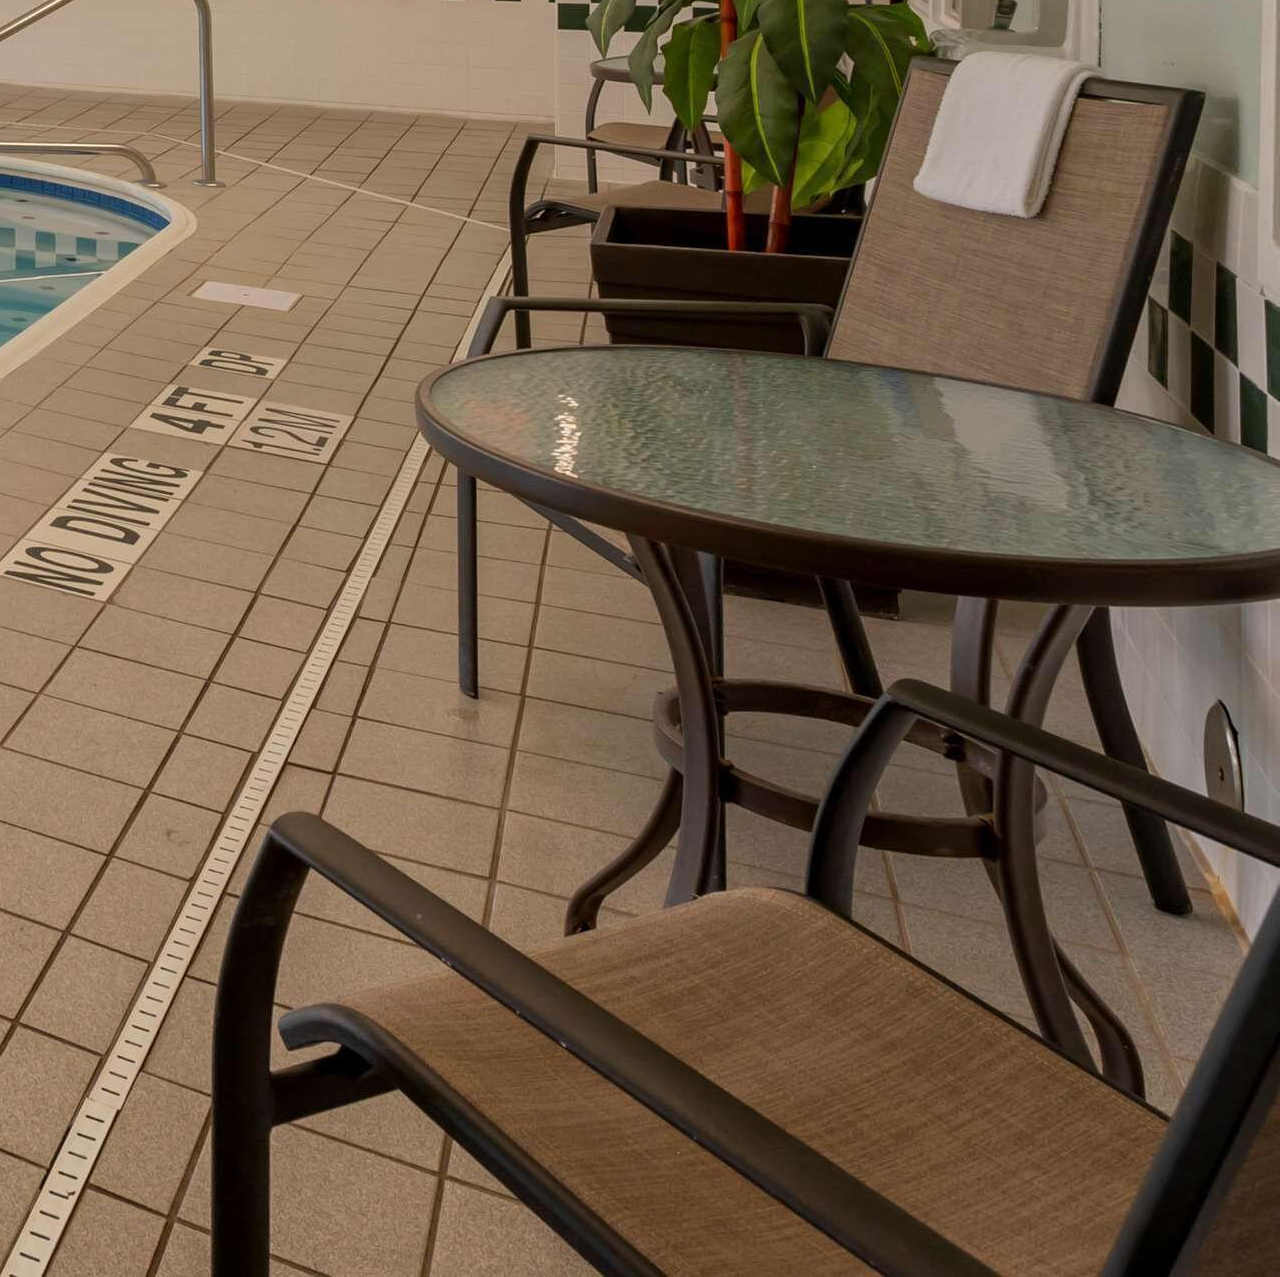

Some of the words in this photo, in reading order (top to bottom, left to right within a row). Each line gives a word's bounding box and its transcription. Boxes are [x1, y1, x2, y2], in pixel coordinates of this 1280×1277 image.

[199, 349, 274, 376] DP
[241, 407, 340, 456] 1.2M
[49, 457, 191, 546] DIVING
[4, 546, 115, 597] NO
